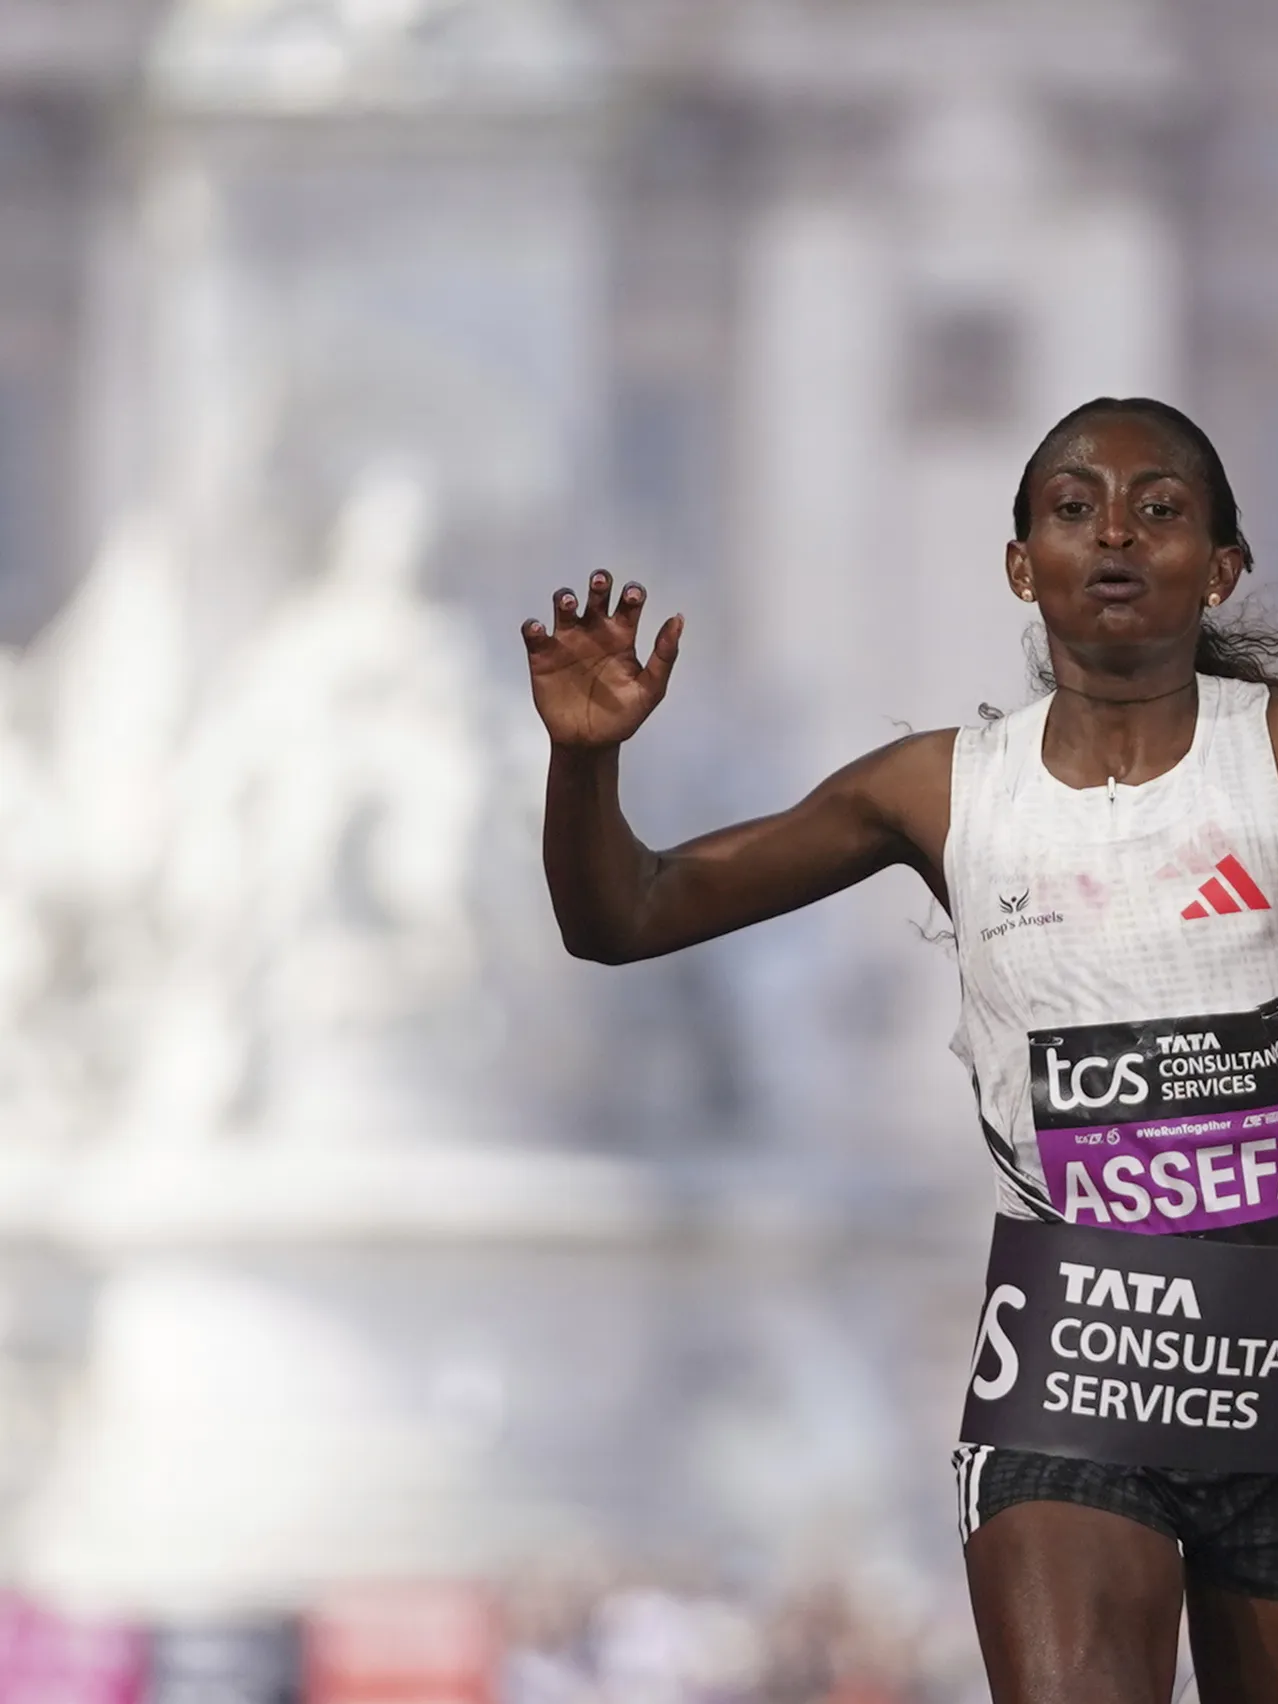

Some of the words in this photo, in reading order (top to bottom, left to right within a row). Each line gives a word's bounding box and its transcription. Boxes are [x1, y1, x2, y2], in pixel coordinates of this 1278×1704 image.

[980, 918, 1015, 941] Tirop's
[1019, 911, 1064, 926] Angels
[1156, 1032, 1221, 1054] TATA
[1047, 1047, 1149, 1110] tcs
[1161, 1074, 1257, 1100] SERVICES
[1136, 1120, 1232, 1138] #WeRunTogether
[1059, 1262, 1201, 1319] TATA
[1043, 1372, 1259, 1430] SERVICES
